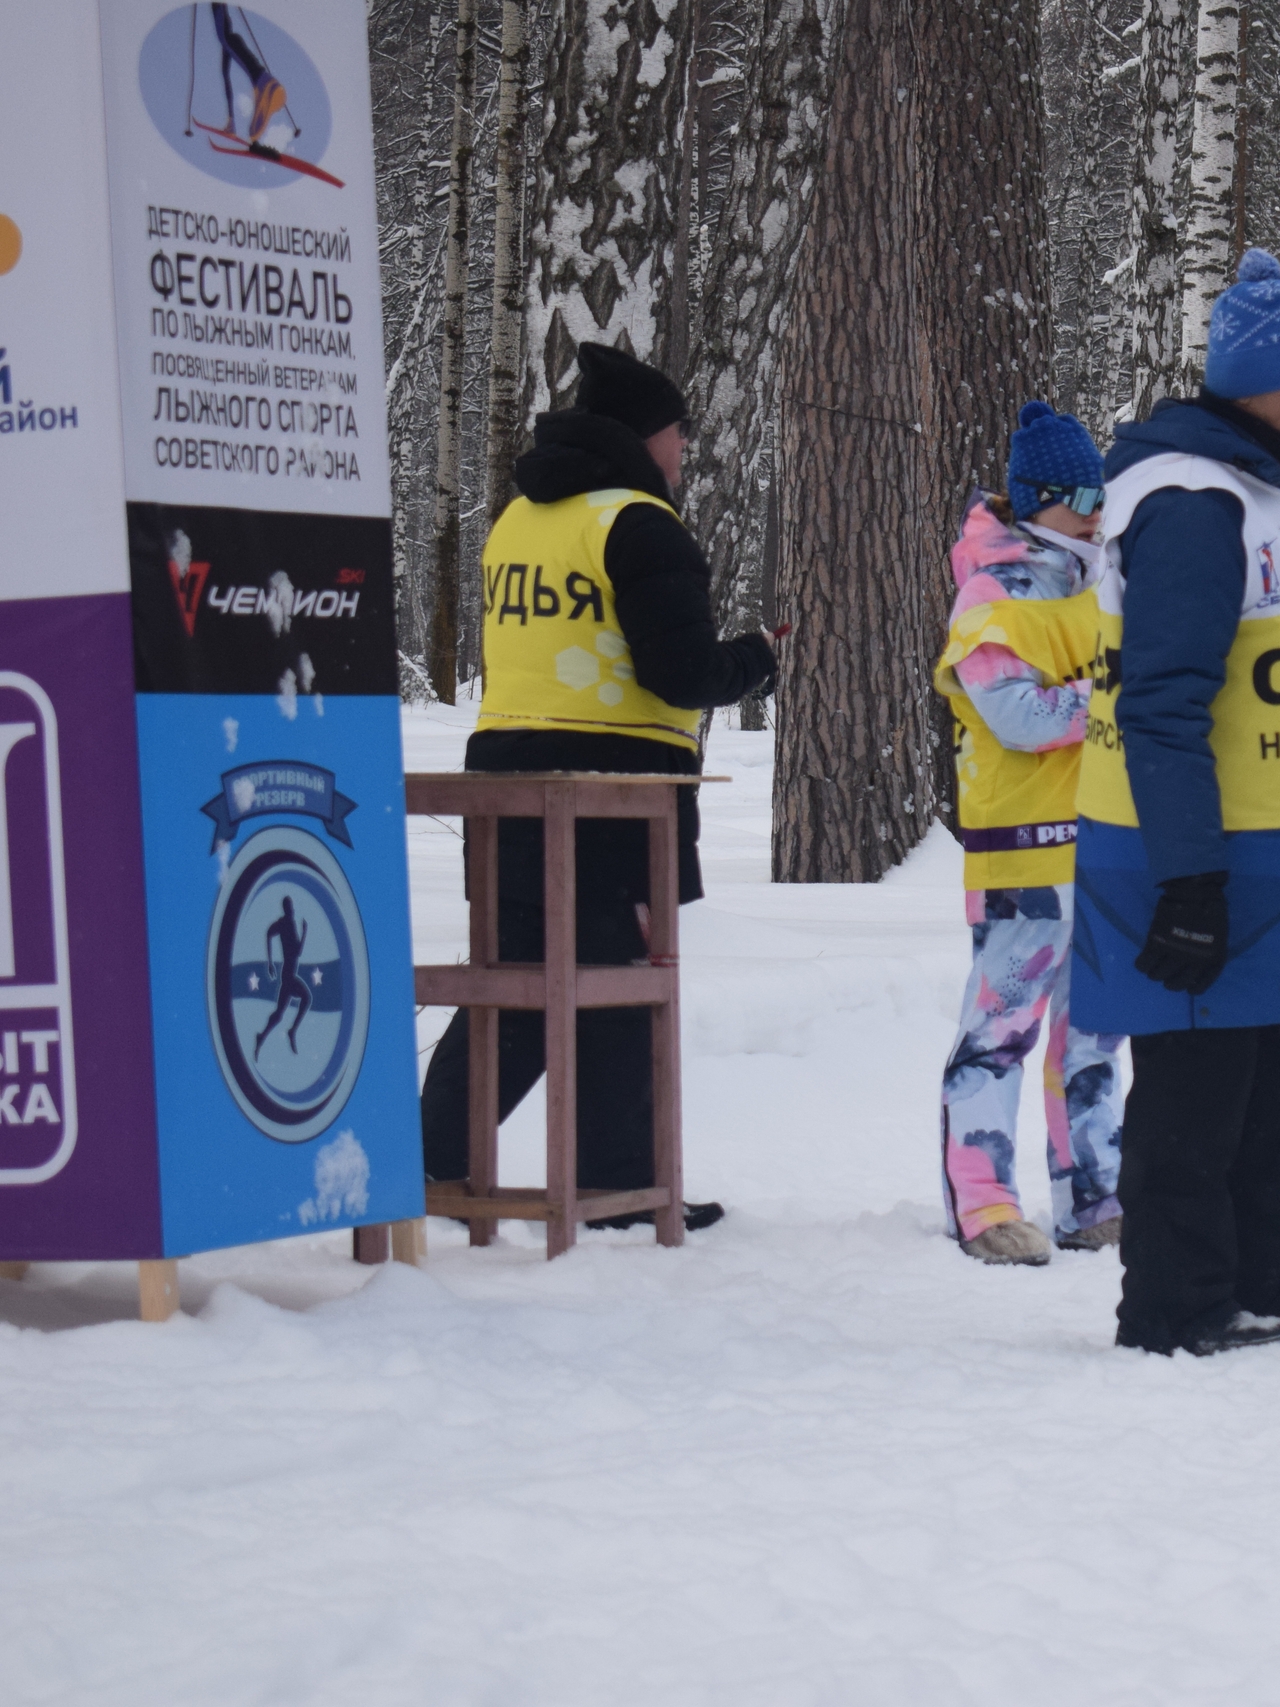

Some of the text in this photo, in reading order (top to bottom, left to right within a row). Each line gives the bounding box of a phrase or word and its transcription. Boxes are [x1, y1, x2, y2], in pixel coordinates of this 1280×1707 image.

[147, 205, 352, 263] ДЕТСКО-ЮНОШЕСКИЙ
[150, 250, 353, 324] ФЕСТИВАЛЬ
[151, 308, 357, 360] ПО ЛЫЖНЫМ ГОНКАМ,
[151, 352, 271, 387] ПОСВЯЩЕННЫЙ
[154, 387, 272, 432] ЛЫЖНОГО
[155, 437, 279, 476] СОВЕТСКОГО
[208, 586, 360, 617] ЧЕМИОН
